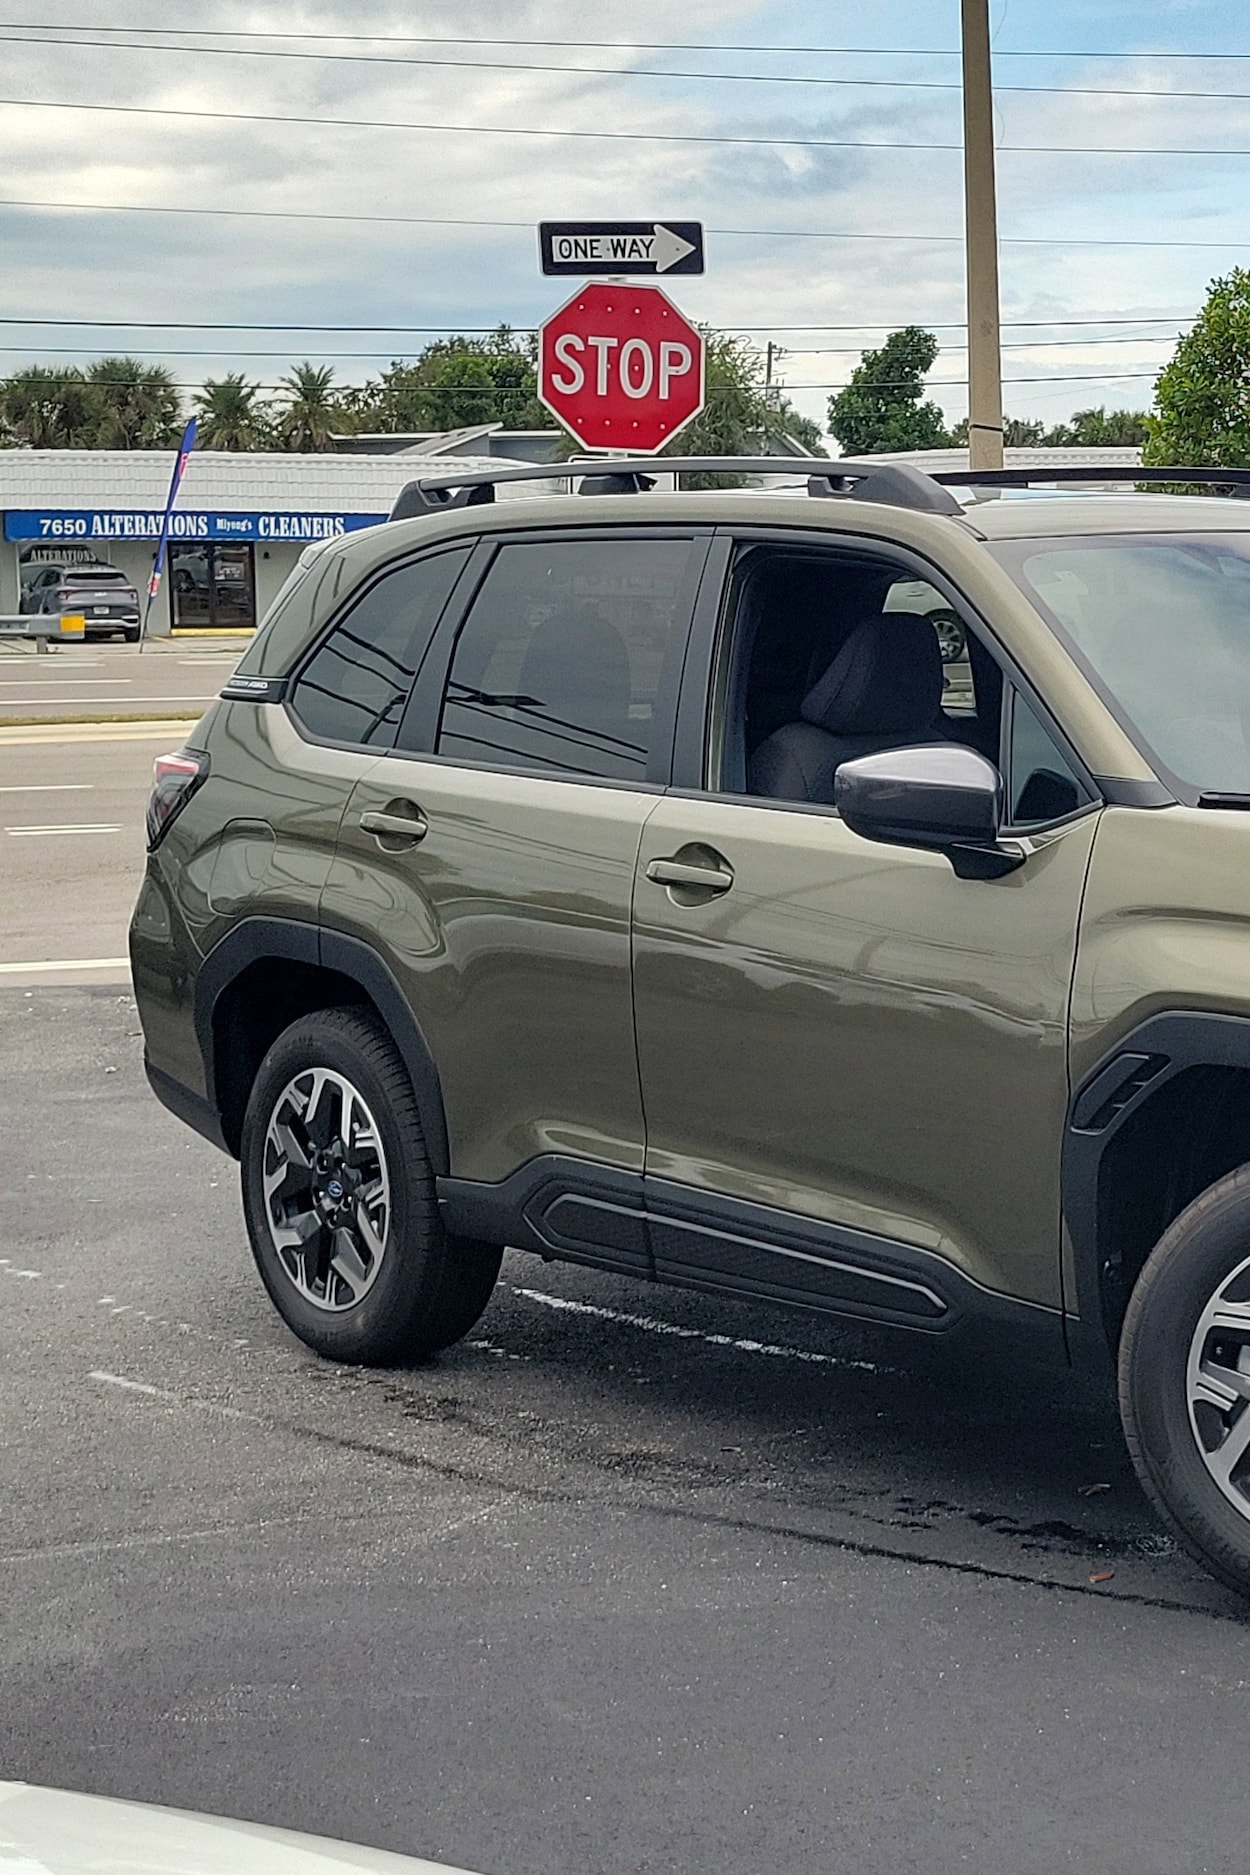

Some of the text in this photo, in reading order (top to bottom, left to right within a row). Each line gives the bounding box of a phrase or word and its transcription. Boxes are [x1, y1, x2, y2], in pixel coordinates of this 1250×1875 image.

[558, 238, 654, 259] ONE WAY
[552, 334, 692, 400] STOP
[40, 519, 87, 535] 7650
[91, 515, 208, 536] ALTERATIONS
[259, 516, 345, 538] CLEANERS
[30, 549, 97, 563] ALTERATIONS
